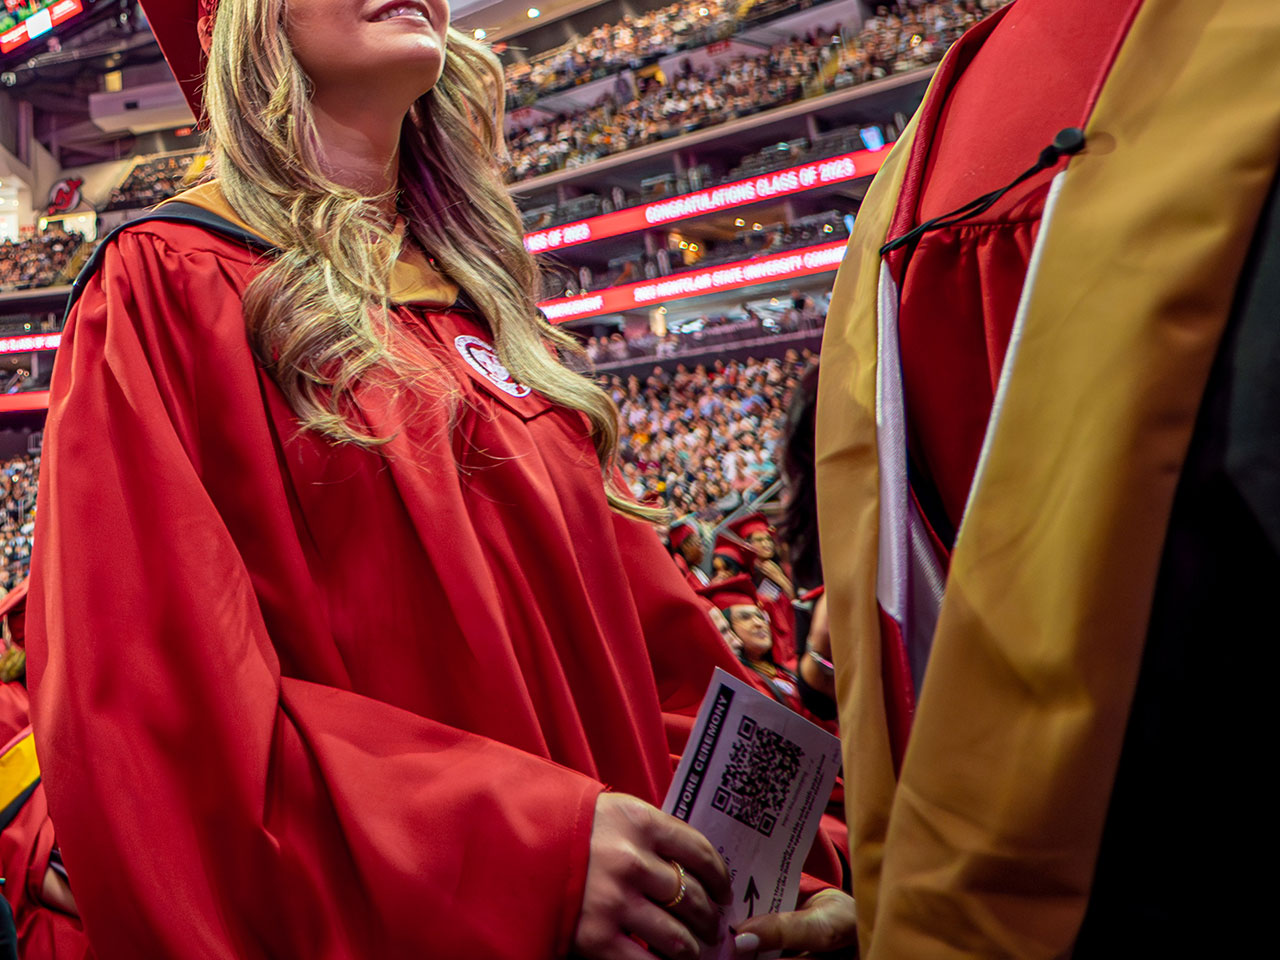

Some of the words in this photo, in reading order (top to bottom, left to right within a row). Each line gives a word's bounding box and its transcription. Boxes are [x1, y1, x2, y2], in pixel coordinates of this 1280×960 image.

[645, 181, 756, 223] CONGRATULATIONS
[757, 171, 799, 198] CLASS
[799, 166, 820, 186] OF
[820, 157, 856, 182] 2023
[675, 773, 699, 821] EFORE
[694, 692, 729, 773] CEREMONY
